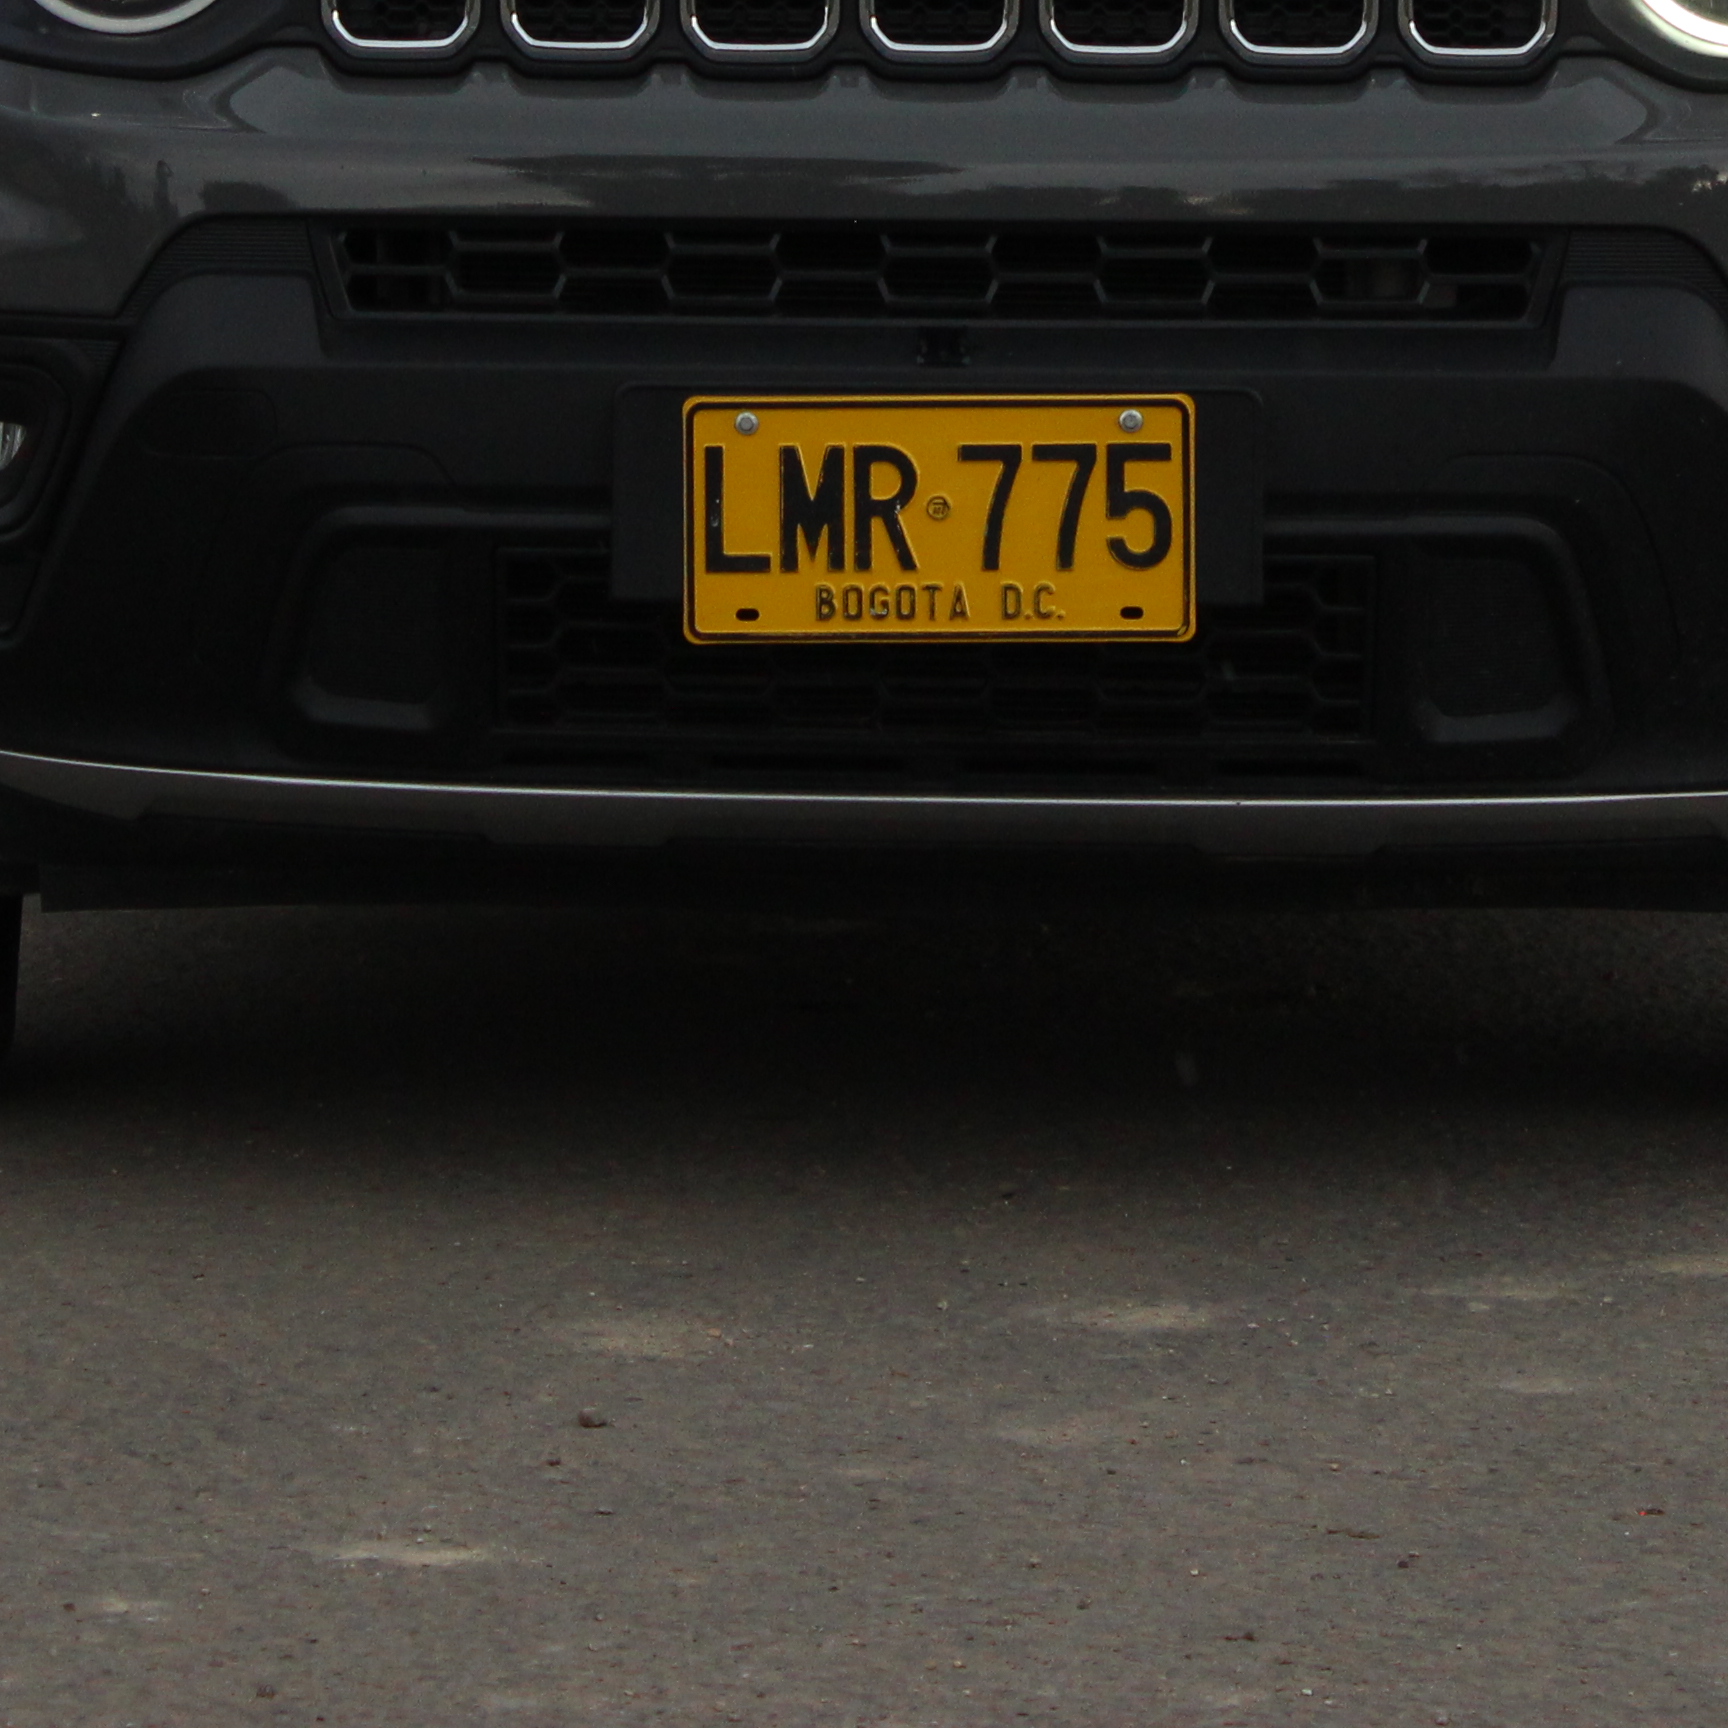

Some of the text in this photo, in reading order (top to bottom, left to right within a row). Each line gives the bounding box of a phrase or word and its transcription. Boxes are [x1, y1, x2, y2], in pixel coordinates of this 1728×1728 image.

[704, 442, 1173, 572] LMR 775
[815, 583, 1065, 622] BOGOTA D.C.
